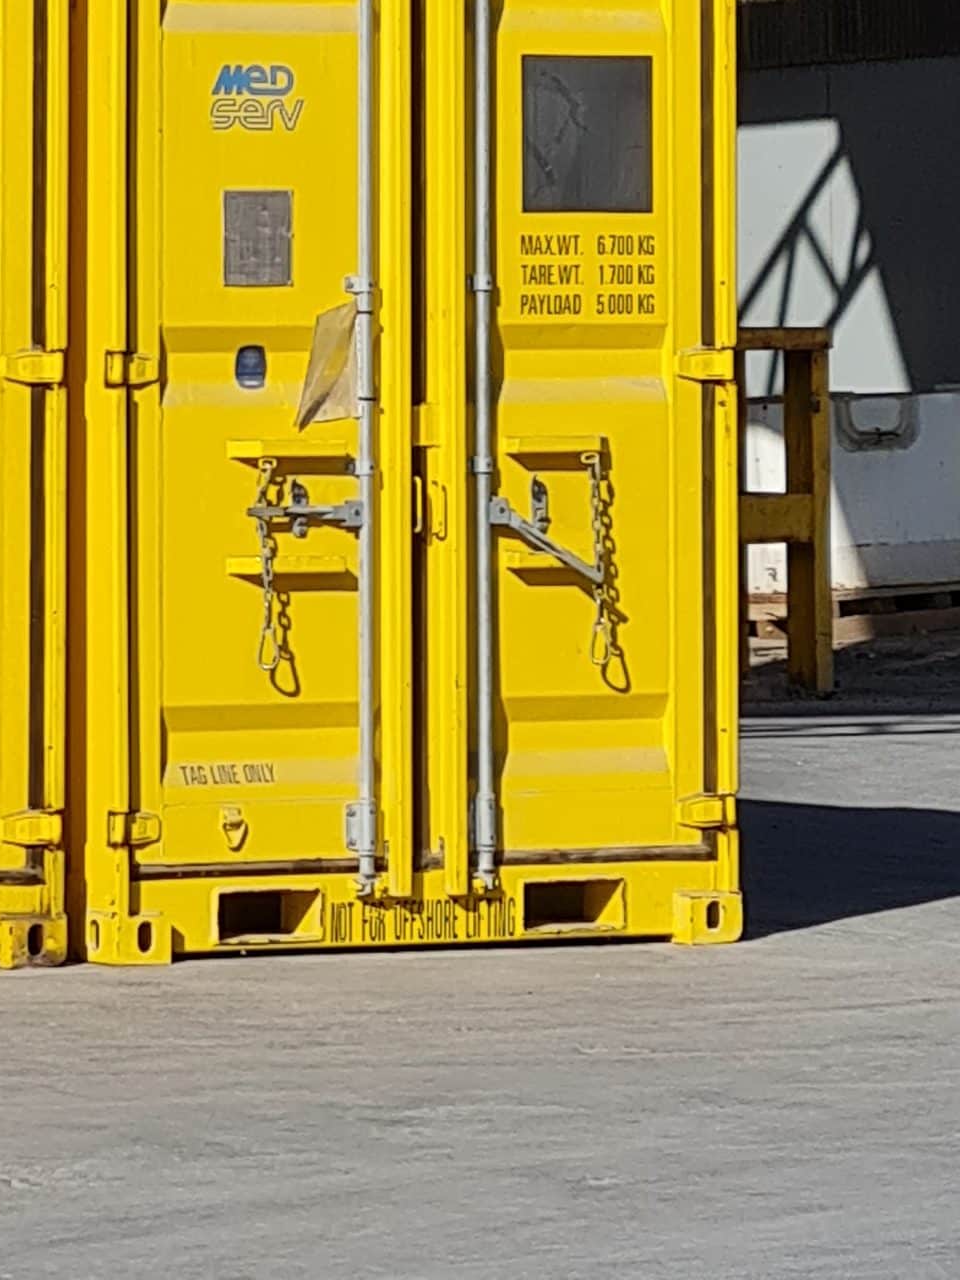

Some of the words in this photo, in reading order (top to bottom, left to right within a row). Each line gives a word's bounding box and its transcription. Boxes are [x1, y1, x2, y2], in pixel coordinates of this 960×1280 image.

[638, 235, 655, 256] KG
[638, 265, 655, 285] KG
[521, 294, 584, 315] PAYLOAD
[597, 294, 633, 315] 5000
[638, 294, 655, 315] KG
[180, 765, 208, 786] TAG
[210, 764, 240, 785] LINE
[243, 763, 275, 783] ONLY
[331, 901, 354, 943] NOT
[394, 896, 458, 941] OFFSHORE
[466, 896, 515, 939] LIFTING
